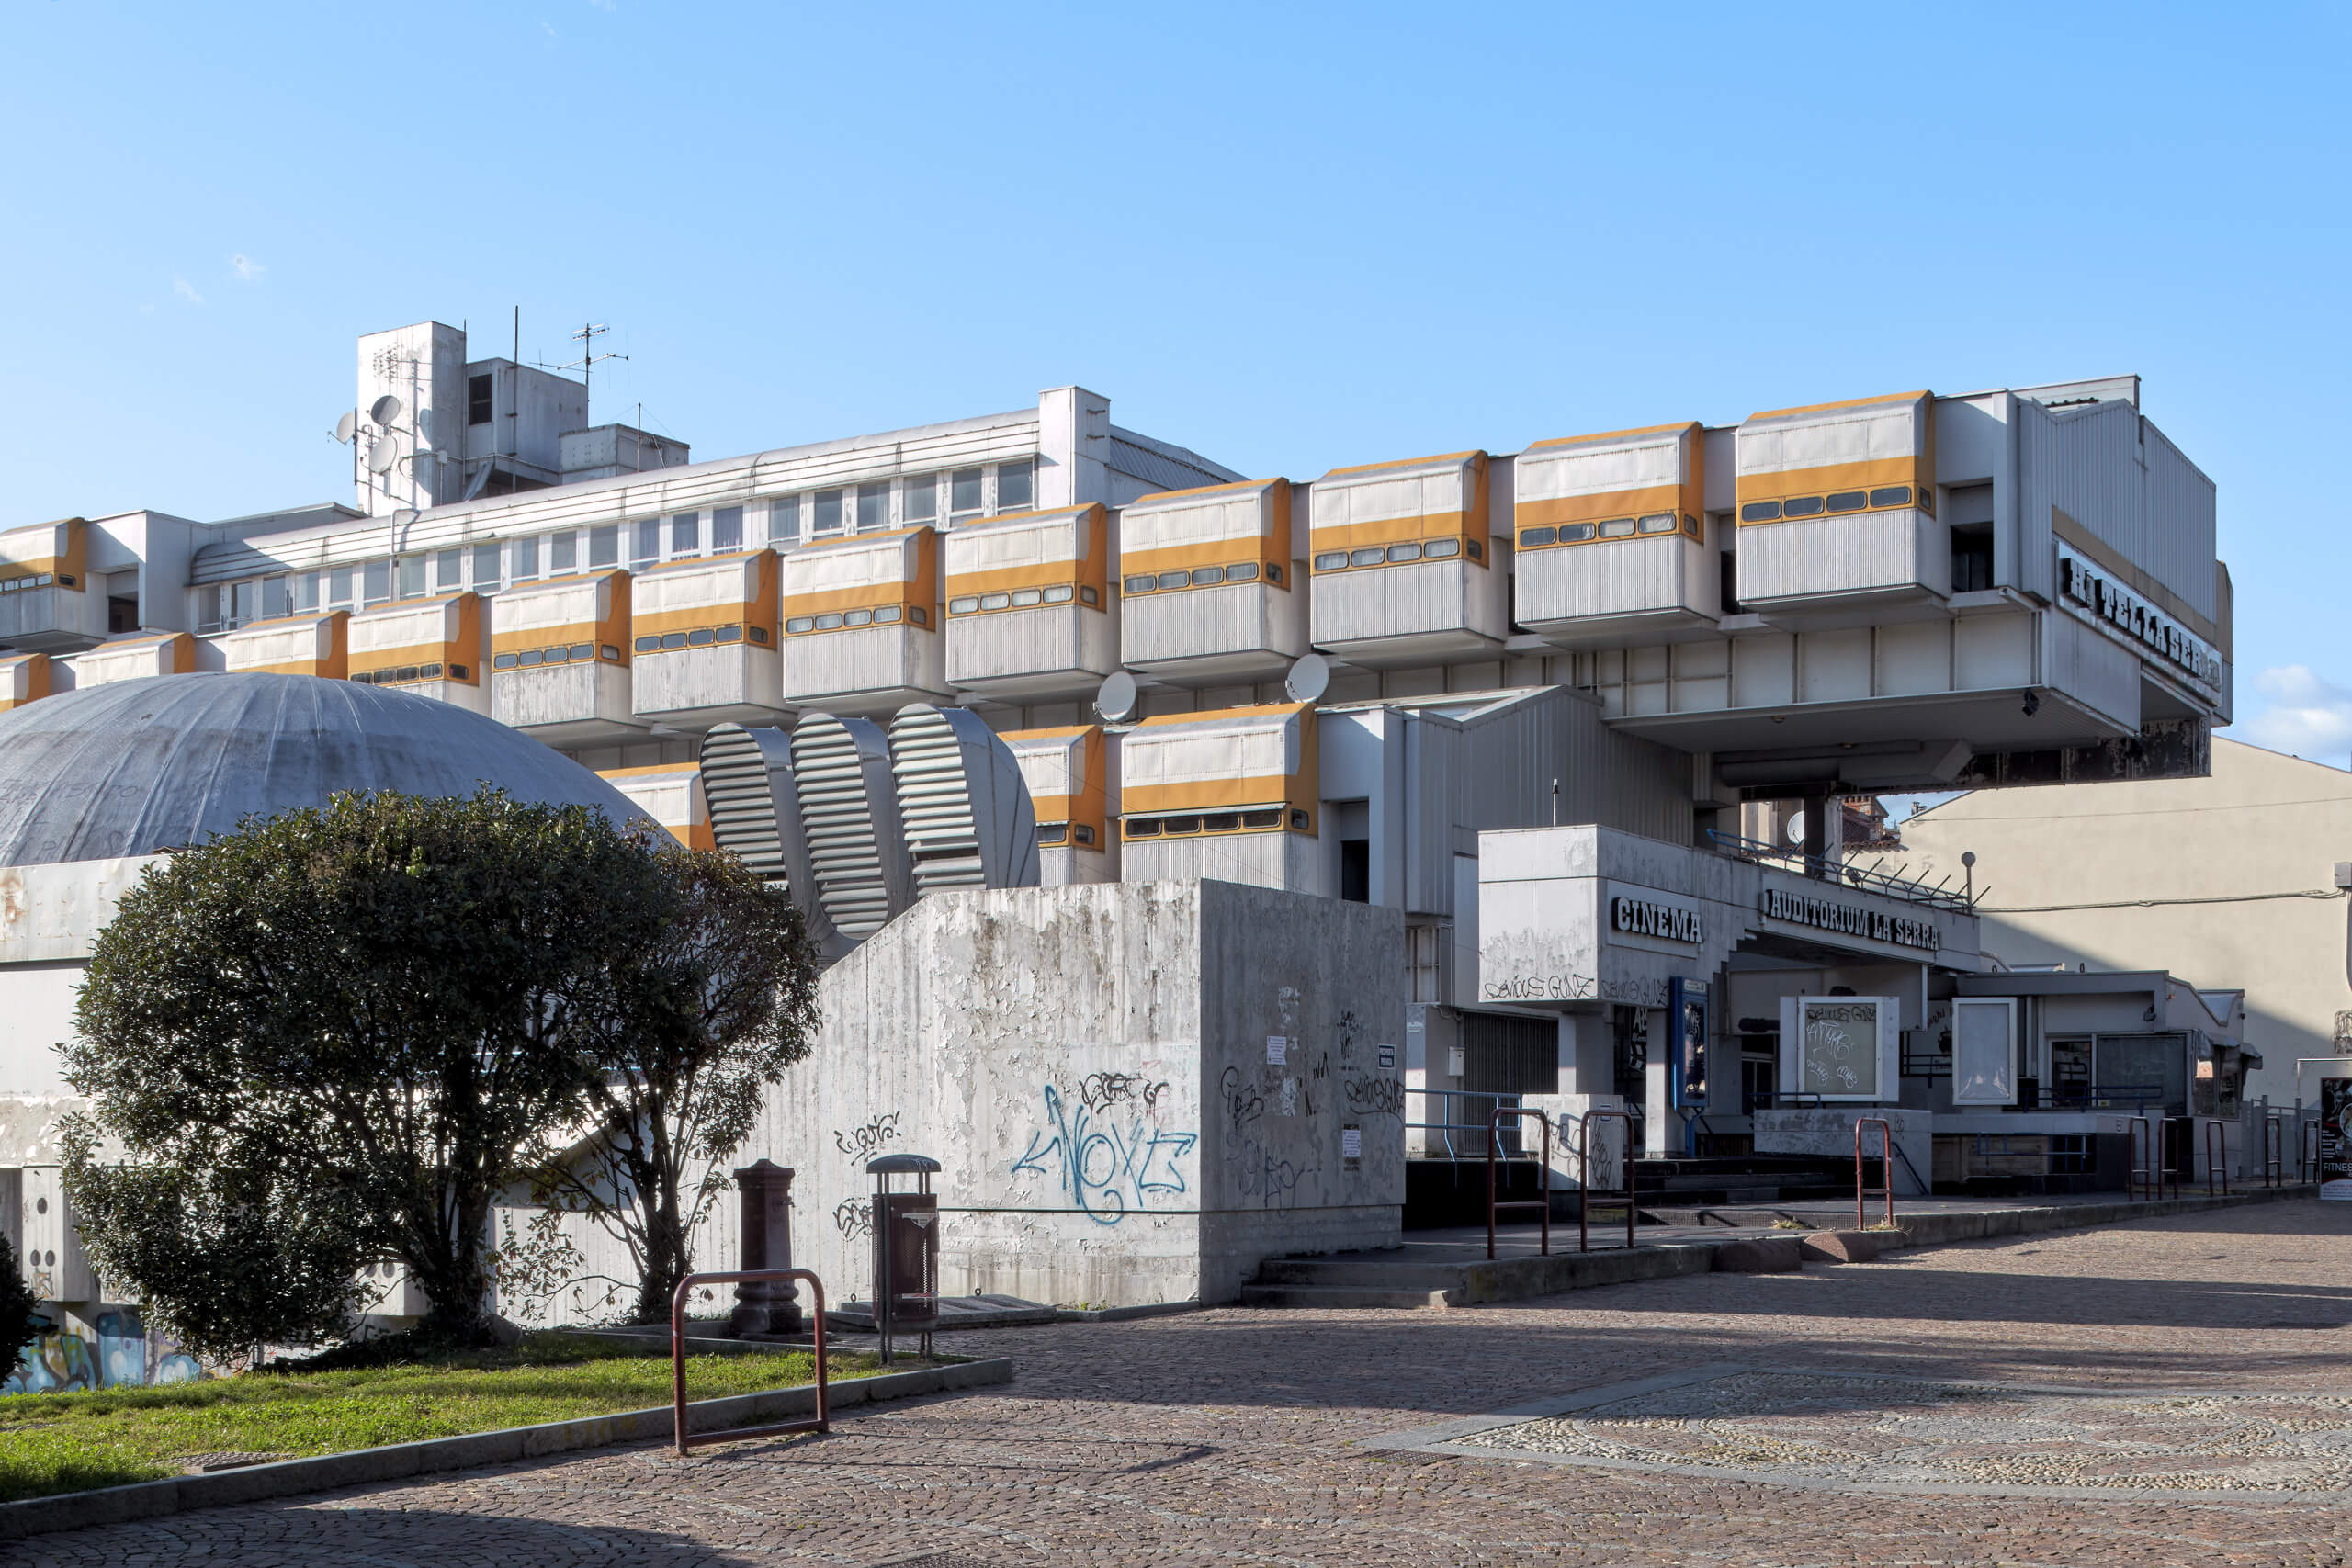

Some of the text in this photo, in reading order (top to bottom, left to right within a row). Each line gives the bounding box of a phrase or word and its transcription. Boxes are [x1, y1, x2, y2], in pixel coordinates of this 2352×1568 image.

[1612, 897, 1702, 943] CINEMA
[1770, 889, 1940, 952] AUDITORIUM LA SERRA
